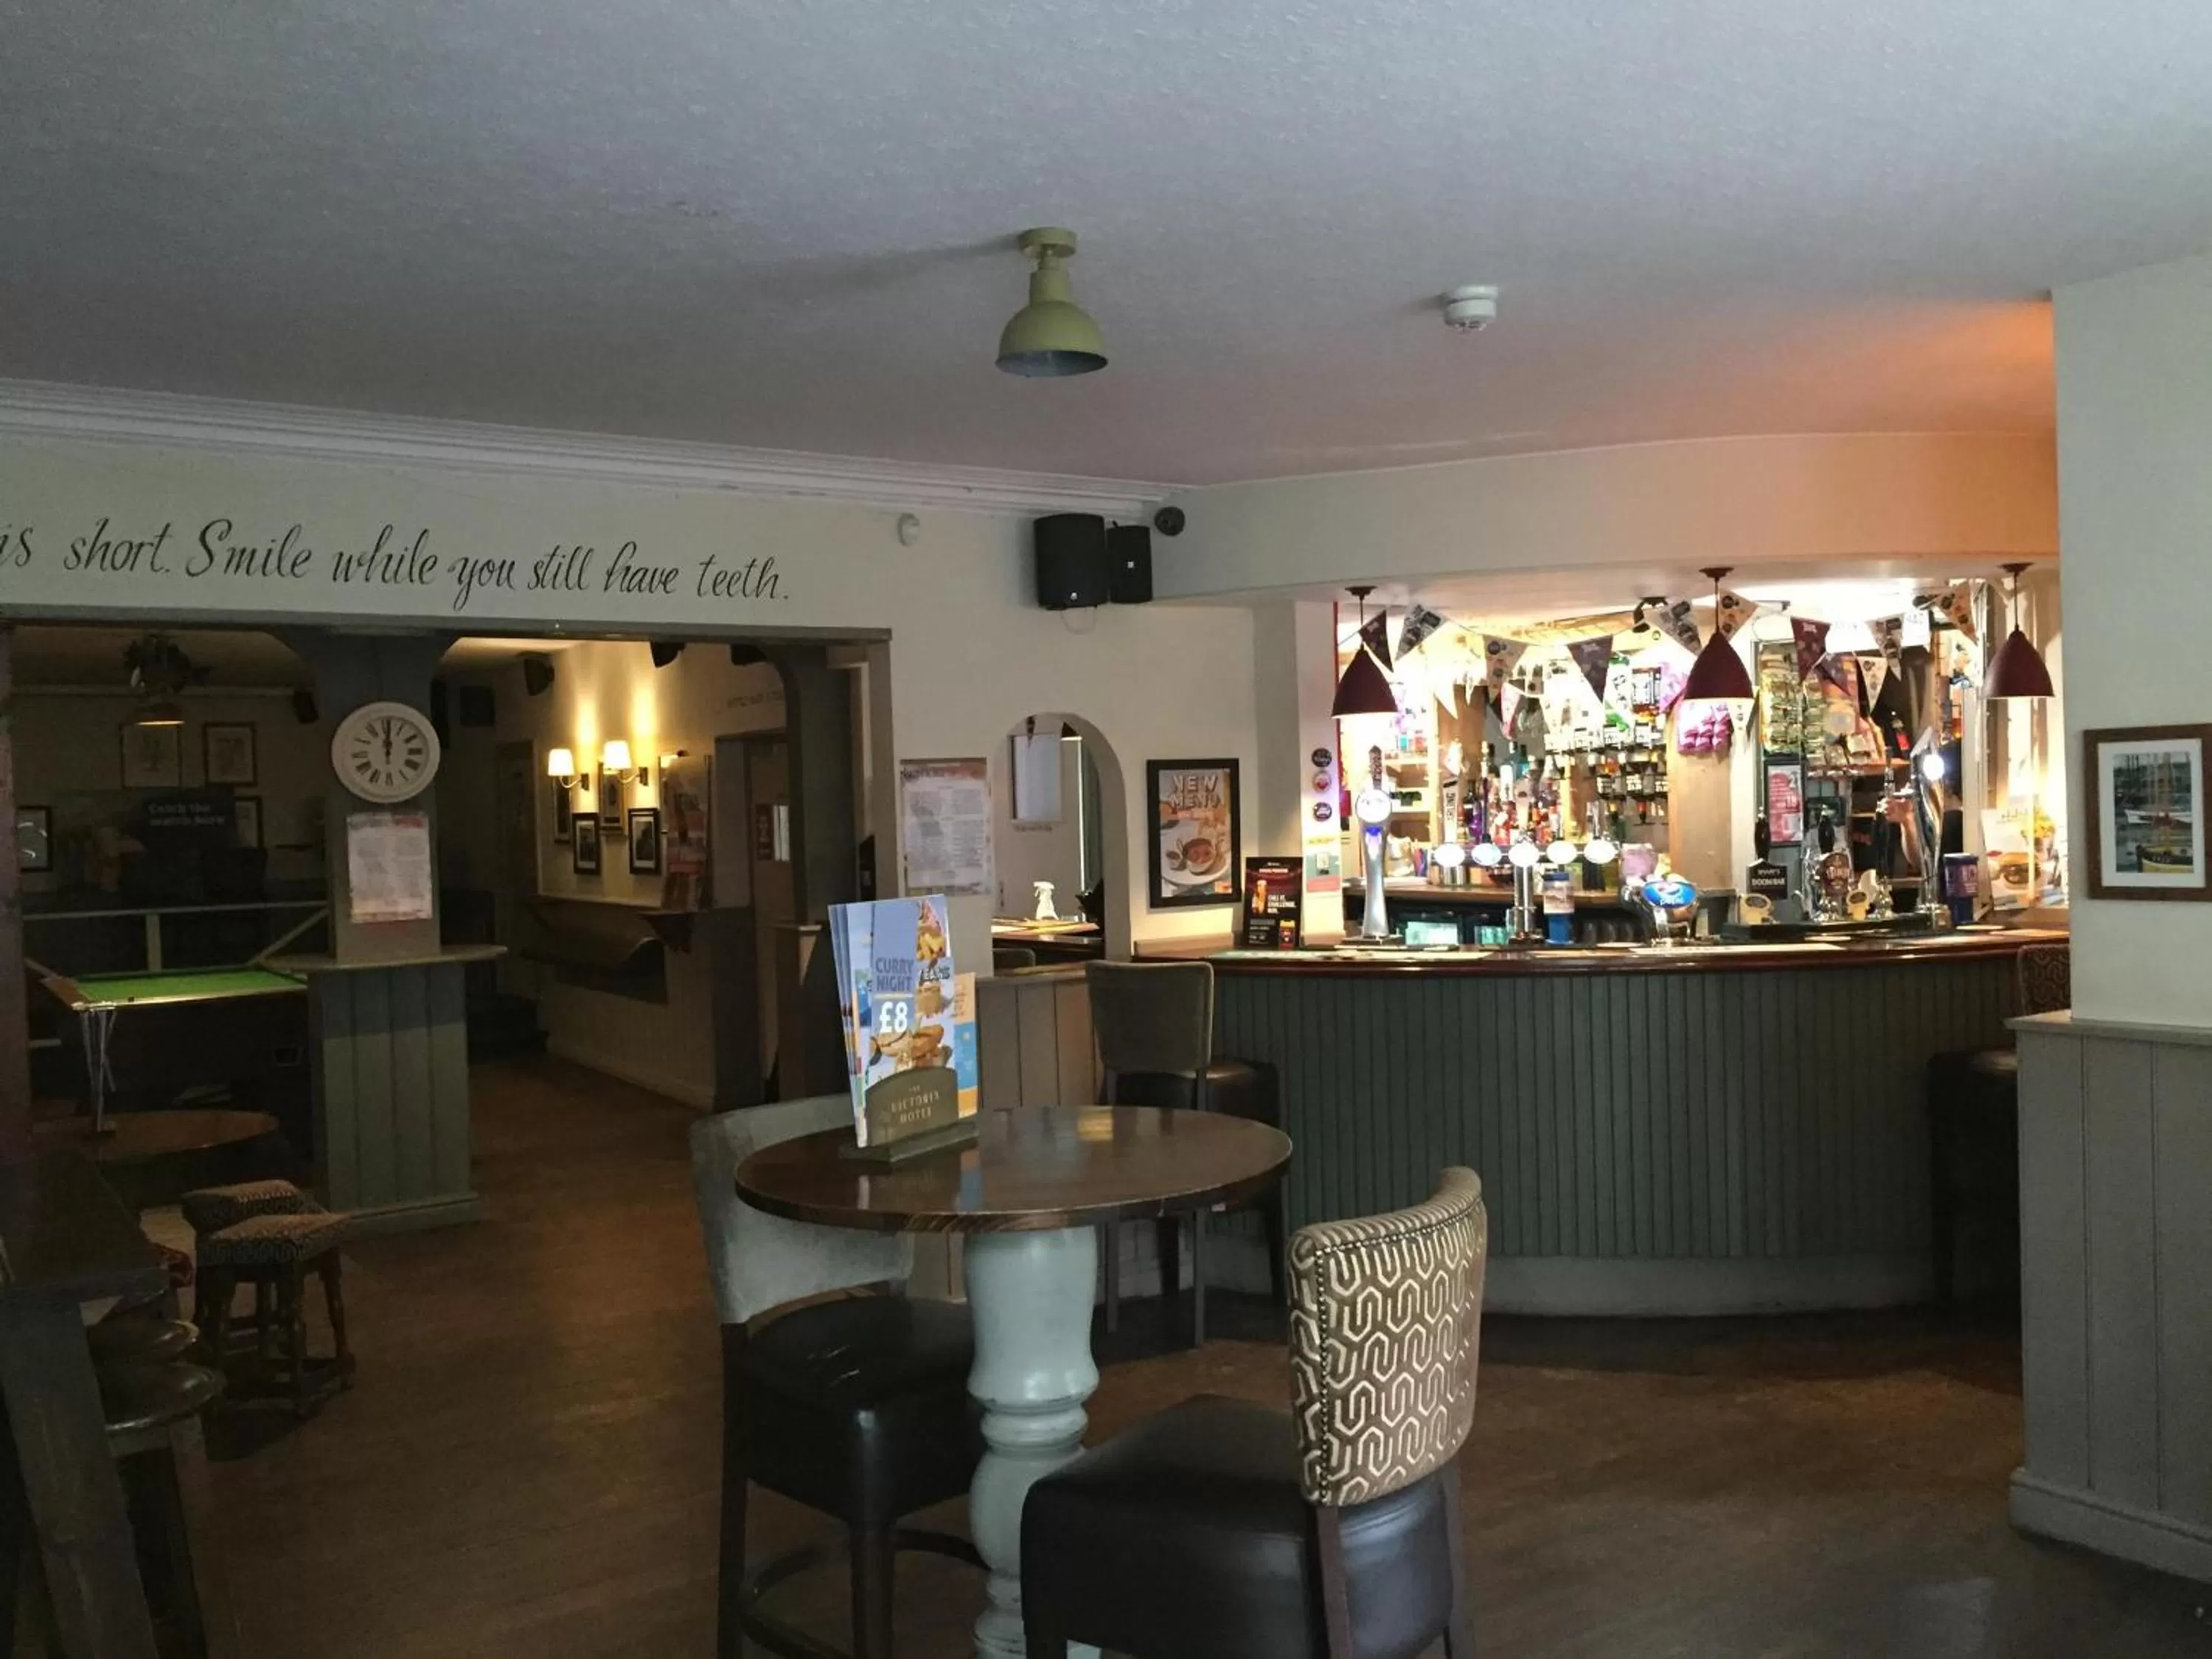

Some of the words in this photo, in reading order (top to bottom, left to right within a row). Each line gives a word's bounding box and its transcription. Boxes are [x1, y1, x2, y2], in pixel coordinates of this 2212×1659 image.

[63, 518, 171, 573] short.
[185, 518, 313, 579] Smile
[332, 524, 438, 585] while
[448, 556, 516, 611] you
[526, 545, 595, 591] still
[603, 540, 679, 594] have
[697, 554, 790, 600] teeth.
[1172, 774, 1218, 793] NEW
[1168, 793, 1222, 809] MENU
[875, 957, 915, 974] CURRY
[876, 975, 913, 992] NIGHT
[879, 1001, 908, 1034] £8
